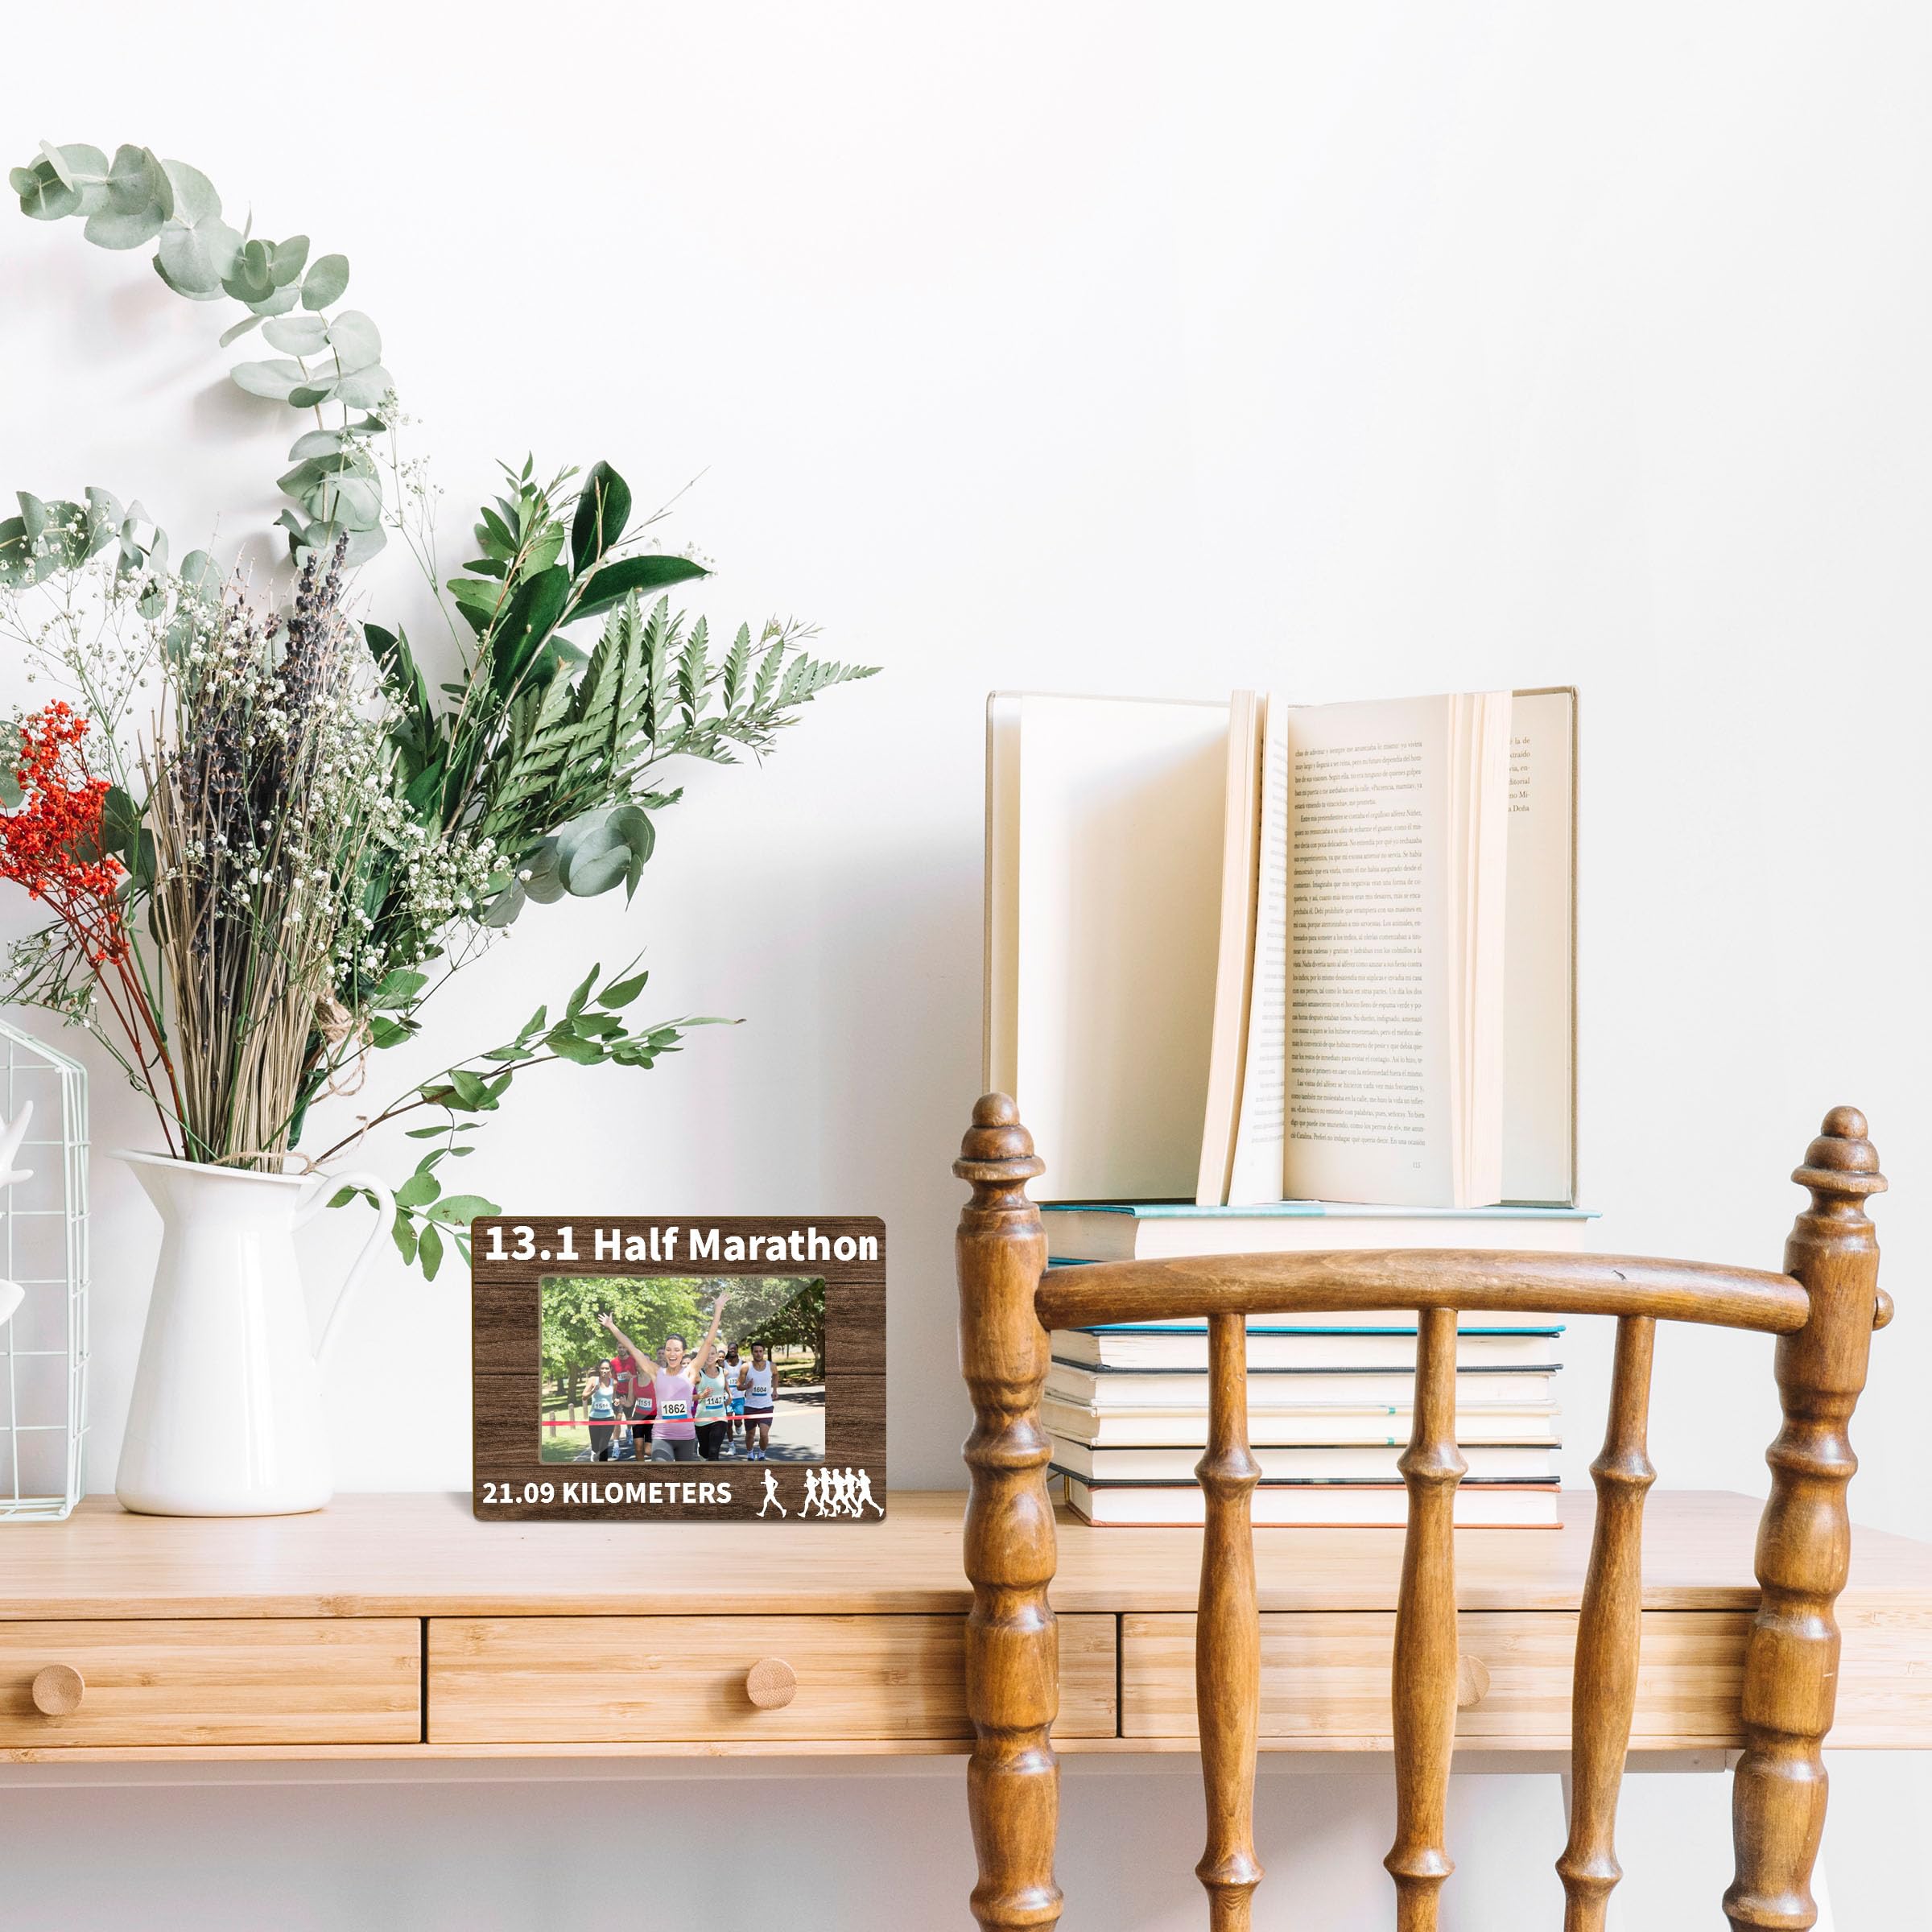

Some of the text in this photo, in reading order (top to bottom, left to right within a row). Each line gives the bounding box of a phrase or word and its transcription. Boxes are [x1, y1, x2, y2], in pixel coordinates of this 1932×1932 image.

[486, 1225, 878, 1261] 13.1 Half Marathon
[663, 1403, 686, 1414] 1862
[707, 1397, 722, 1405] 1147
[482, 1482, 732, 1504] 21.09 KILOMETERS
